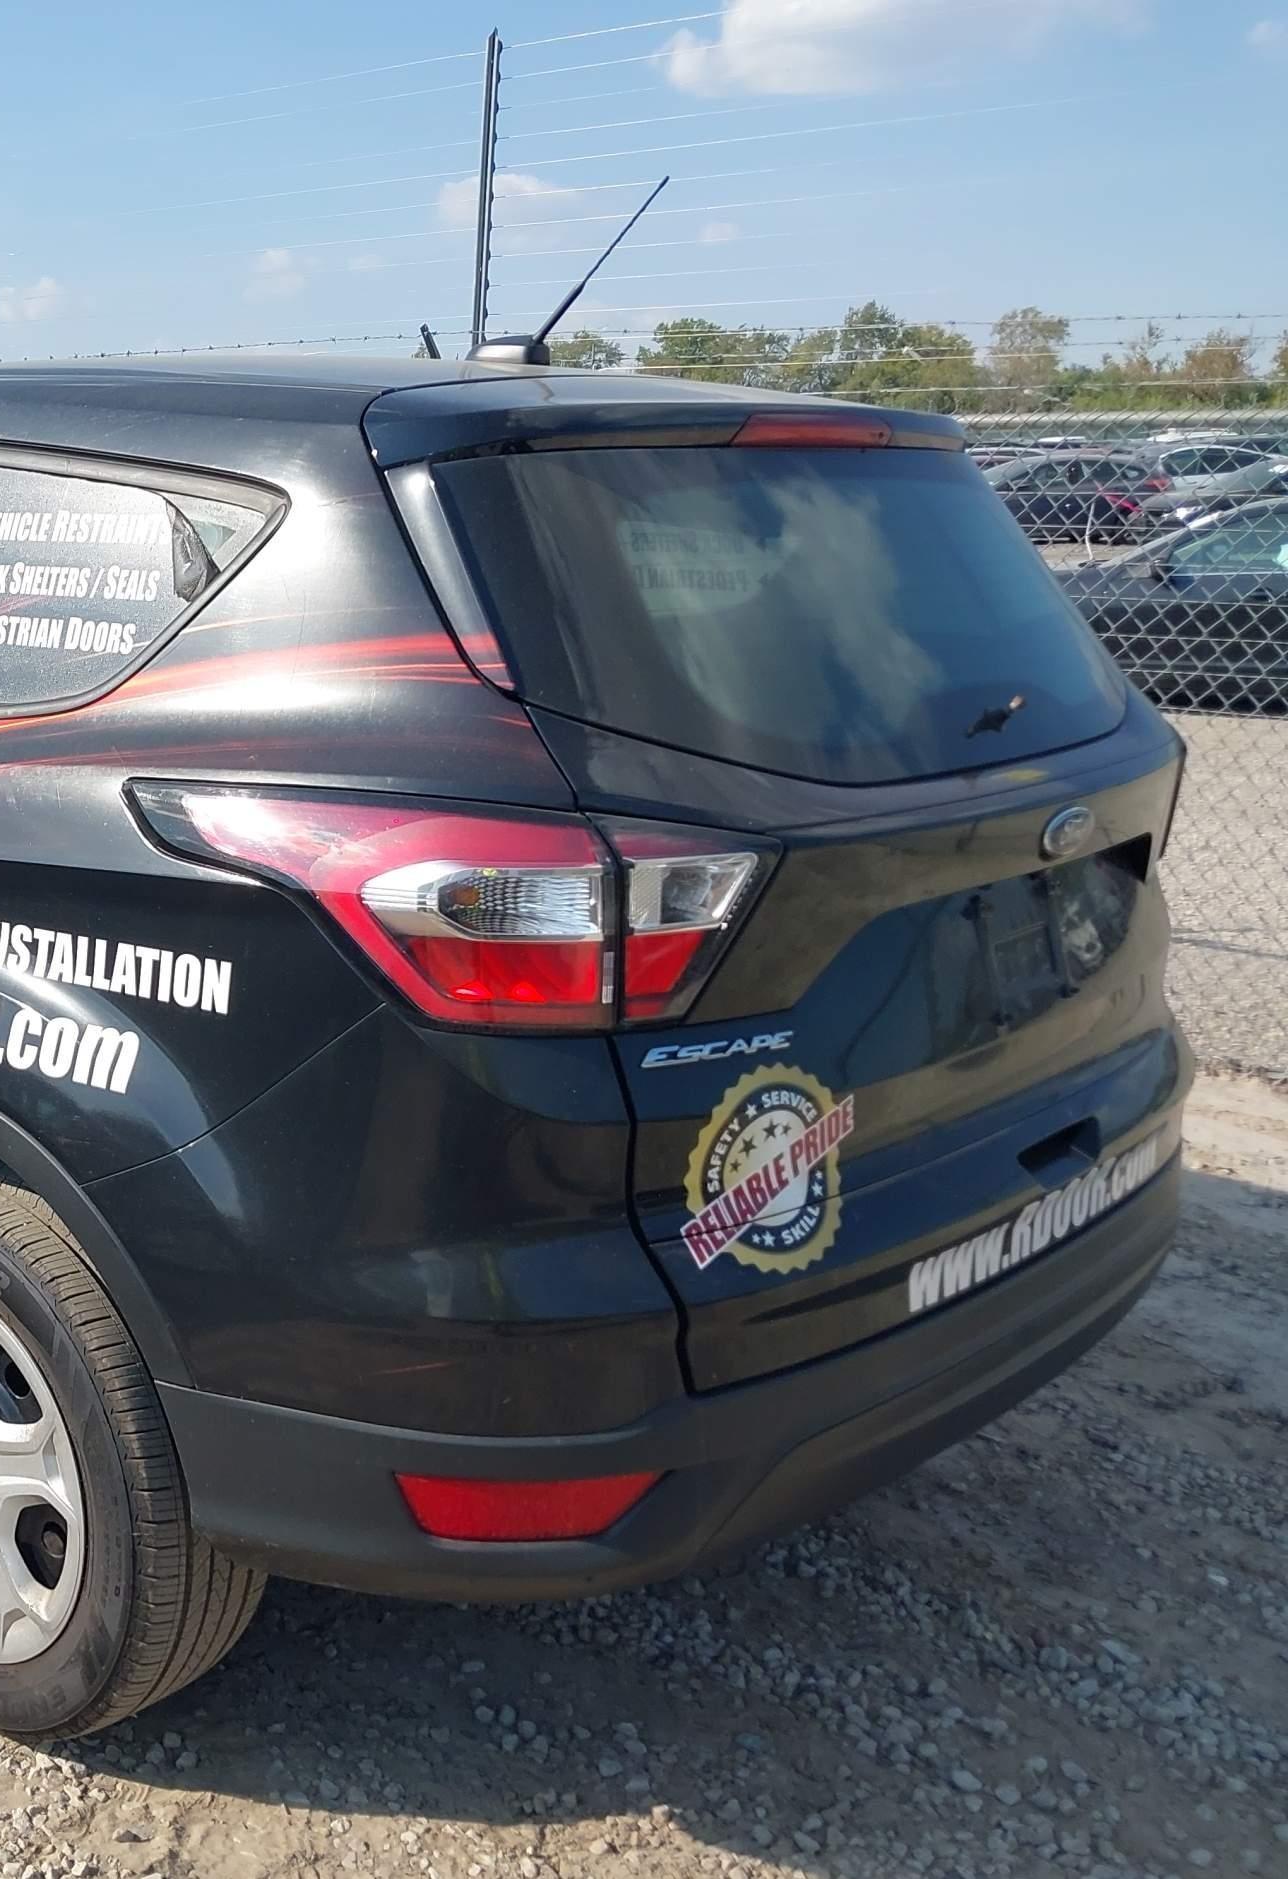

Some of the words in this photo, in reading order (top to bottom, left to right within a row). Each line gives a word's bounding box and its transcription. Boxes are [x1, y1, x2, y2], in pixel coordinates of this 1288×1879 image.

[9, 562, 90, 598] SHELTERS
[90, 572, 102, 598] /
[103, 565, 160, 602] SEALS
[64, 617, 136, 655] DOORS
[640, 1030, 795, 1069] ESCAPE
[706, 1117, 742, 1194] SAFETY
[761, 1090, 819, 1124] SERVICE
[683, 1151, 790, 1267] RELIABLE
[789, 1099, 855, 1179] PRIDE
[780, 1205, 821, 1245] SKILL
